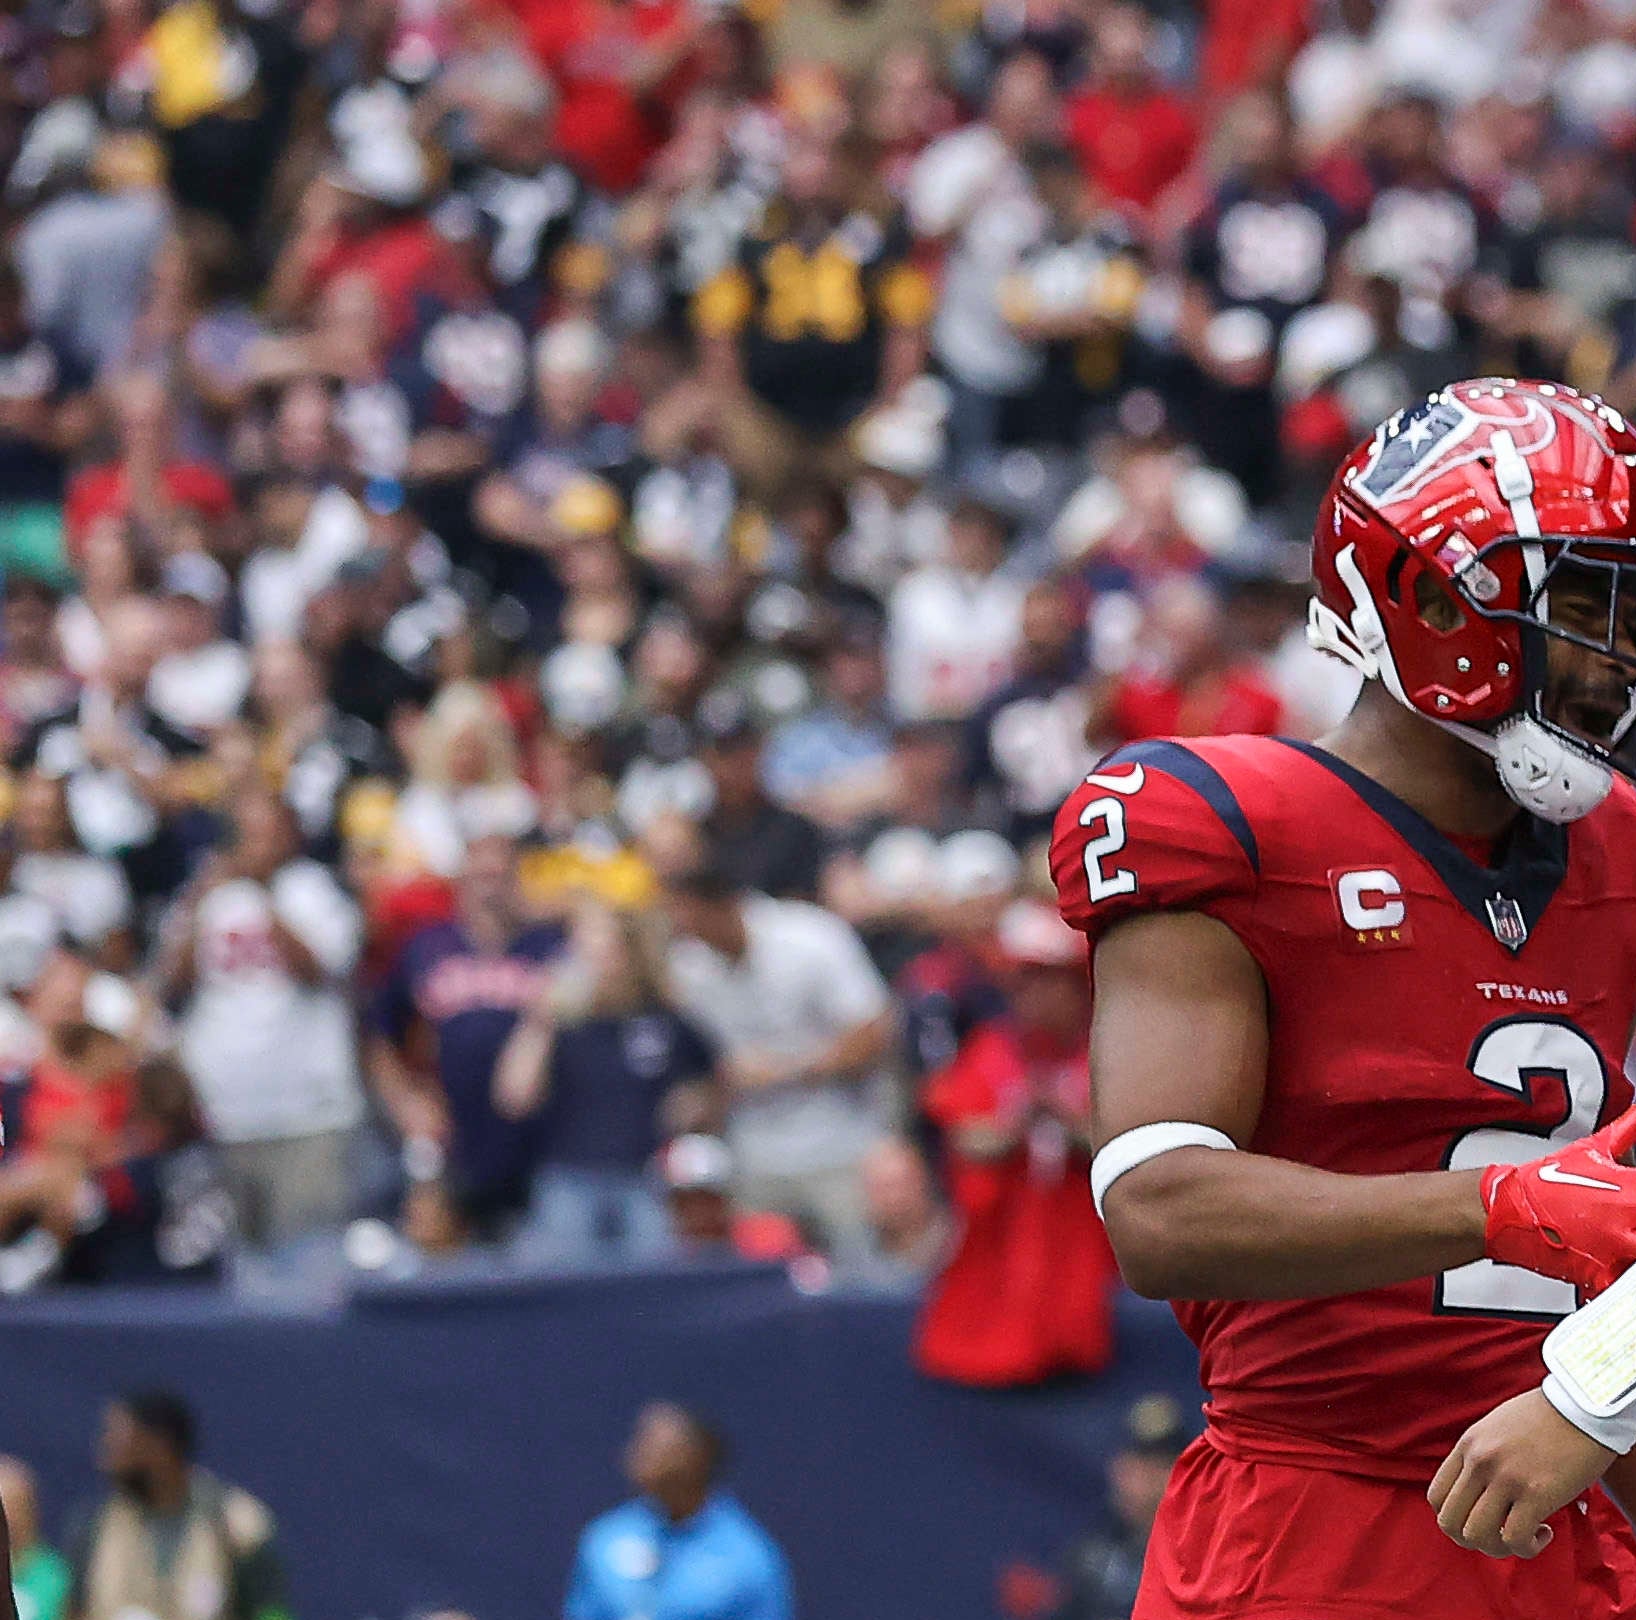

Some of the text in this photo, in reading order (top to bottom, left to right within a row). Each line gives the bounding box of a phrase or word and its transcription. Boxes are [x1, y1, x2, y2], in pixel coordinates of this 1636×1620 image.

[1078, 796, 1139, 904] 2
[1336, 868, 1406, 931] C
[1475, 982, 1569, 1006] TEXANS
[1433, 1012, 1608, 1318] 2
